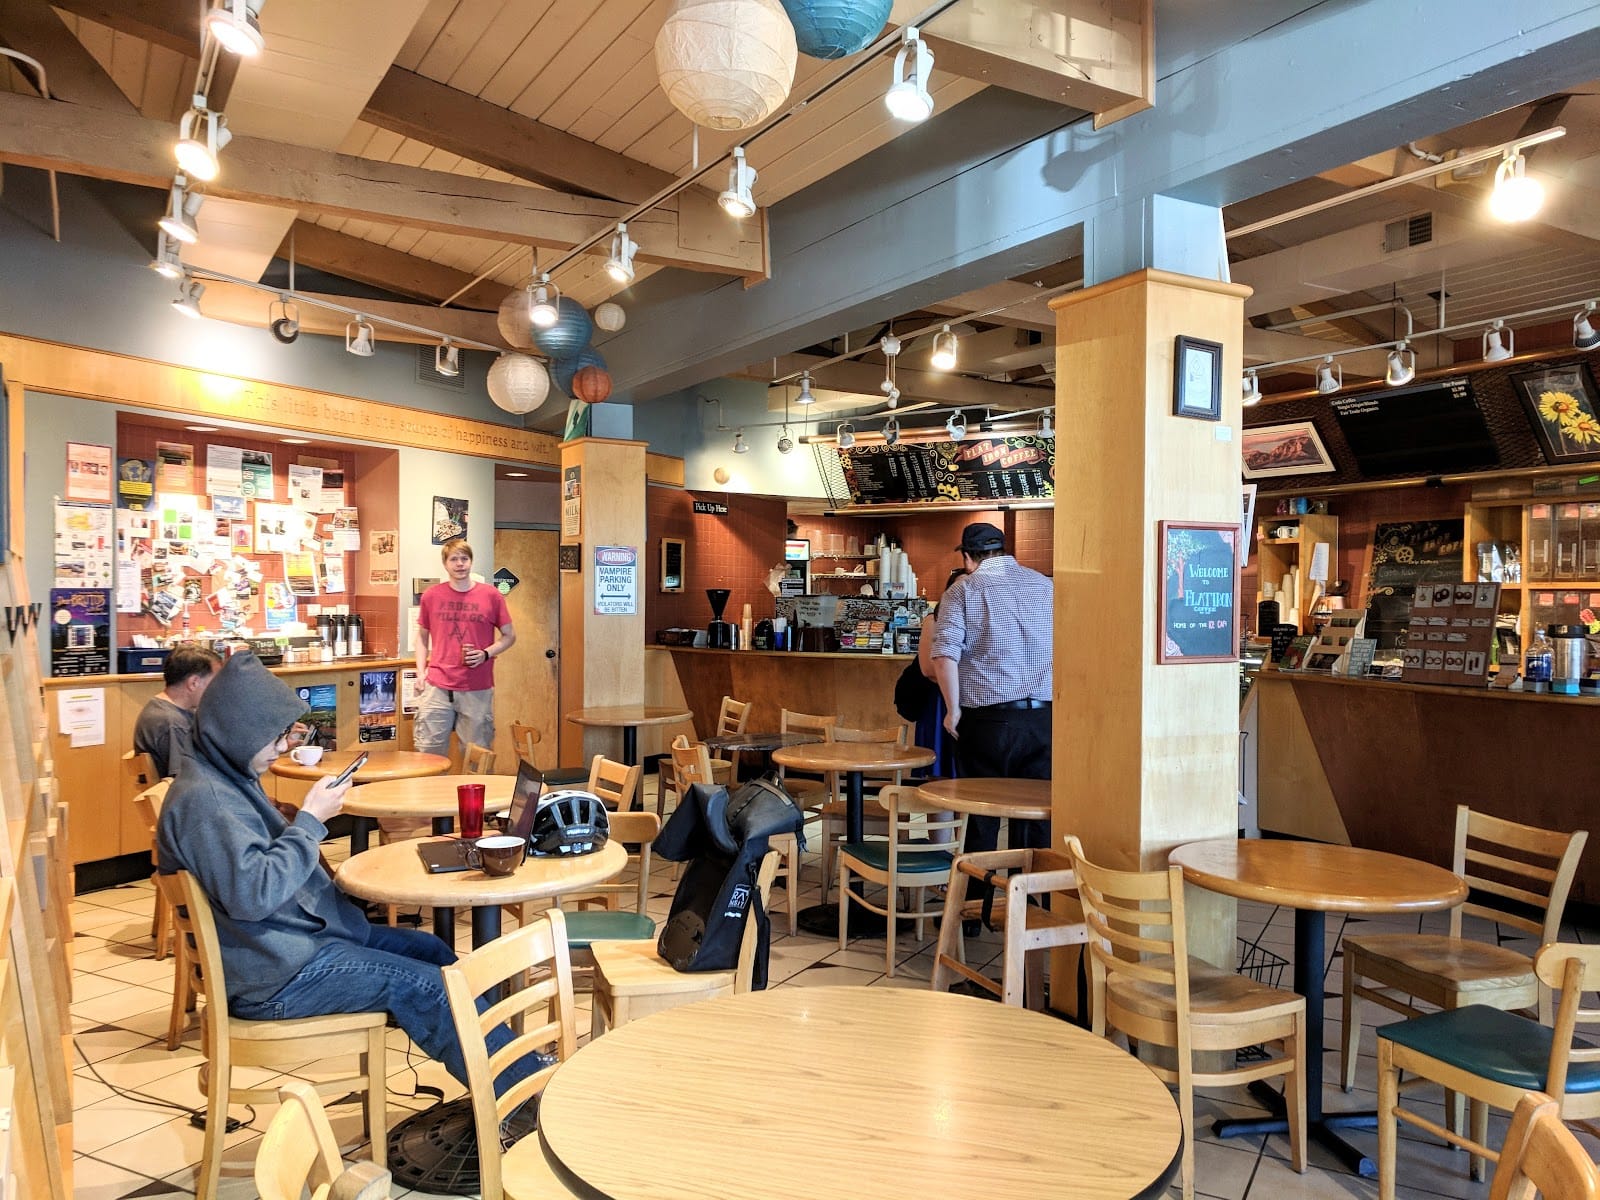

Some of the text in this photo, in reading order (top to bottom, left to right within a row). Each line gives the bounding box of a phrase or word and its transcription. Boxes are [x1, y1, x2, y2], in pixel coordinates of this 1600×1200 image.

[455, 425, 508, 448] happiness
[511, 437, 529, 451] and
[966, 442, 990, 458] FLAT
[983, 446, 1008, 463] IRON
[1001, 449, 1037, 464] COFFEE
[695, 502, 728, 514] Pick Up Here
[602, 551, 632, 562] WARNING
[599, 567, 633, 576] VAMPIRE
[1188, 563, 1229, 578] WELCOME
[600, 575, 632, 584] PARKING
[606, 583, 626, 592] ONLY
[1184, 590, 1232, 607] FLATIRON
[440, 602, 479, 611] ARDEN
[437, 613, 484, 623] VILLAGE
[363, 672, 395, 686] RUNES
